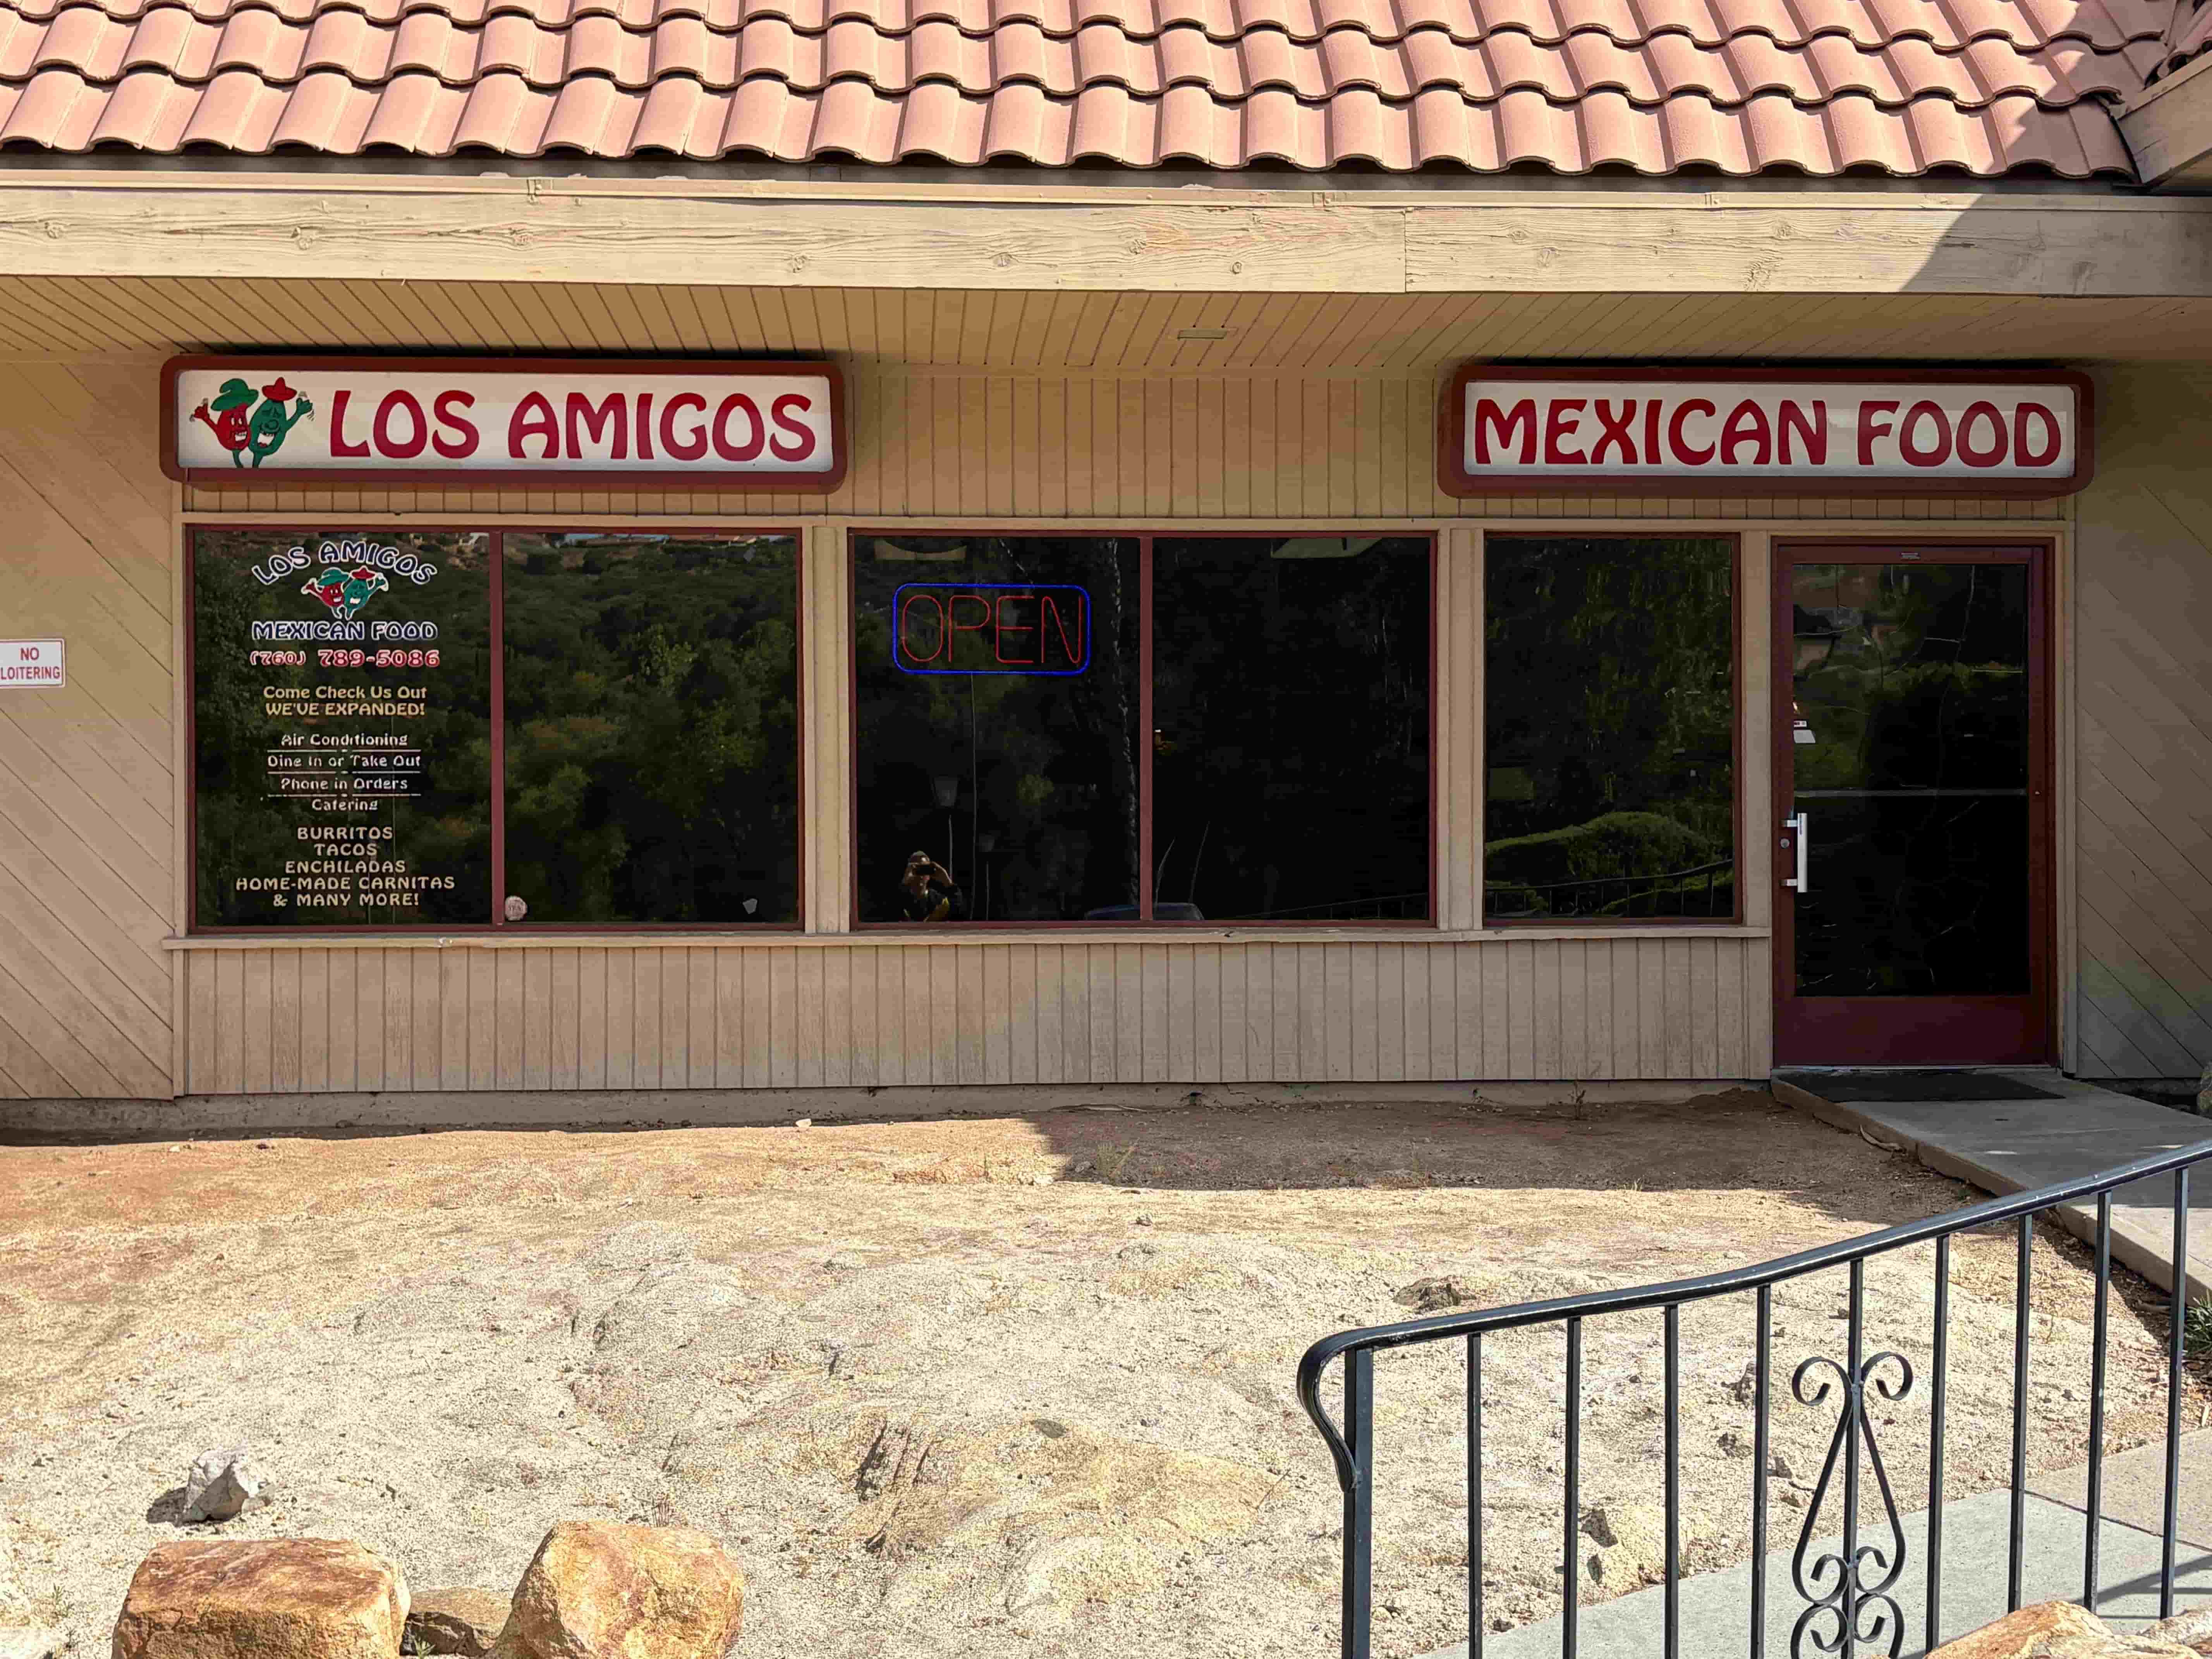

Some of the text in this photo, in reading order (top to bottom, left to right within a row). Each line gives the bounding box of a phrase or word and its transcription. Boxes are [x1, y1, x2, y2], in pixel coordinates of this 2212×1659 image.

[330, 390, 816, 462] LOS AMIGOS
[1475, 398, 2061, 467] MEXICAN FOOD
[252, 541, 438, 585] LOS AMIGOS
[252, 621, 438, 641] MEXICAN FOOD
[902, 594, 1083, 663] OPEN
[20, 647, 39, 660] NO
[250, 649, 440, 667] (760) 789-5086
[0, 666, 60, 679] LOITERING
[263, 686, 427, 699] Come Check Us Out
[266, 703, 425, 716] WE'VE EXPANDED!
[281, 733, 408, 746] Air Conditioning
[268, 755, 421, 767] Dine In or Take Out
[281, 778, 408, 790] Phone in Orders
[312, 799, 378, 811] Catering
[297, 827, 393, 840] BURRITOS
[314, 843, 377, 856] TACOS
[285, 860, 405, 873] ENCHILADAS
[235, 876, 455, 890] HOME-MADE CARNITAS
[273, 893, 419, 907] & MANY MORE!
